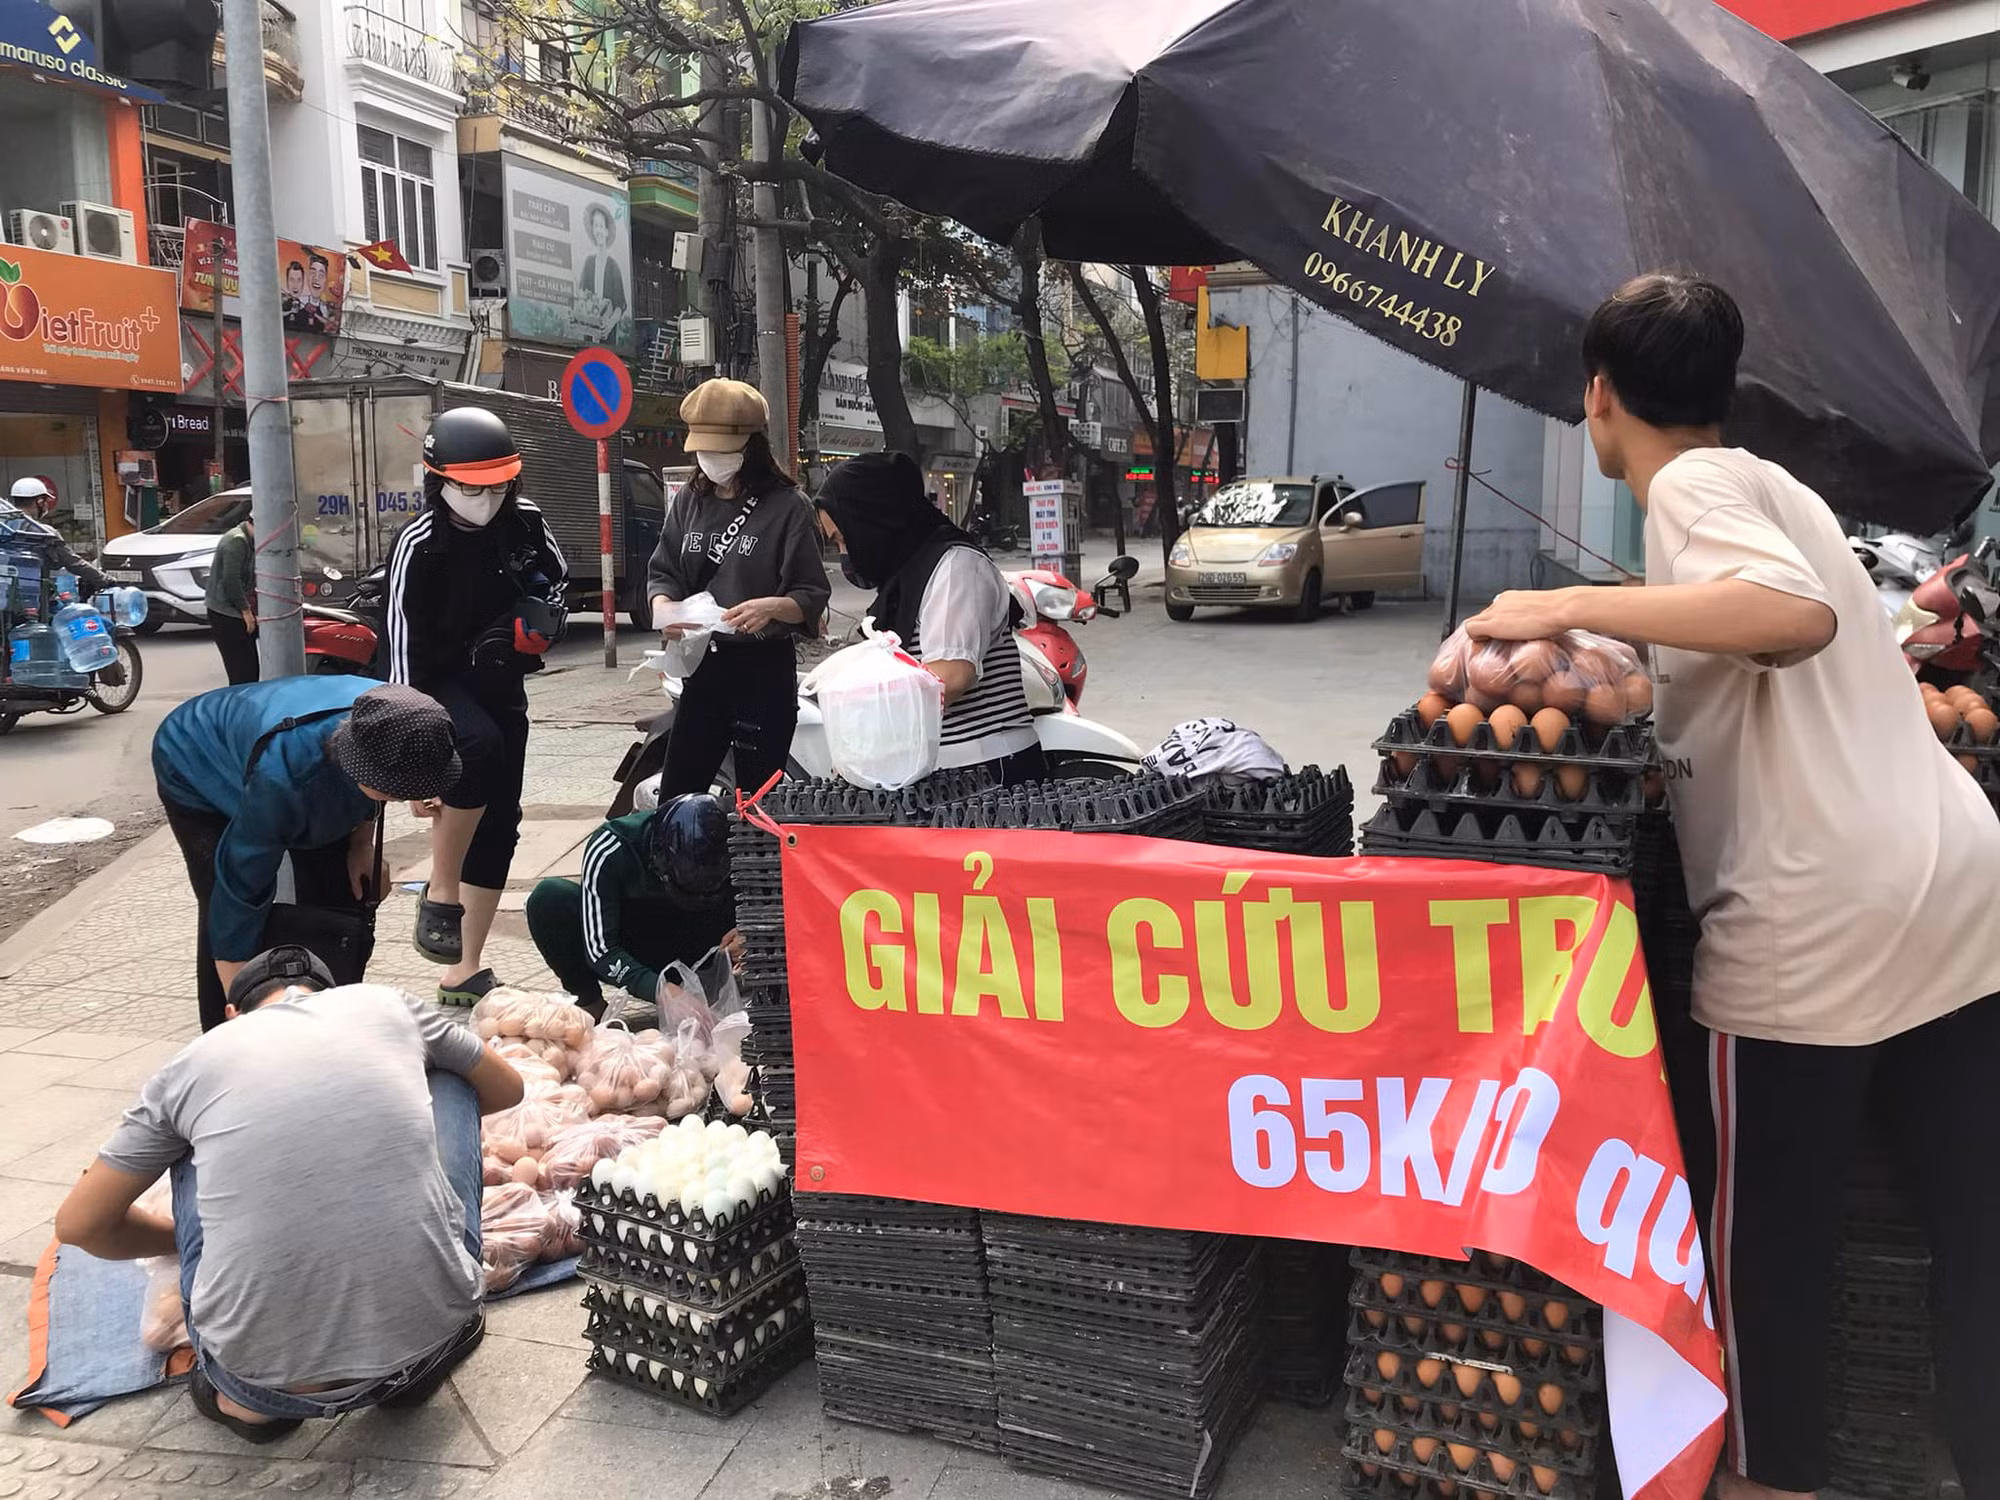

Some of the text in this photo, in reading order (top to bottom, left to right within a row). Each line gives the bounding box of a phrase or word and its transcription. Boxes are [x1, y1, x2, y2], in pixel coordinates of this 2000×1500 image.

[0, 41, 66, 72] maruso
[1321, 197, 1496, 297] KHANH LY
[1304, 251, 1462, 347] 0966744438
[177, 414, 209, 430] Bread
[318, 495, 350, 515] 29H
[376, 491, 424, 513] 045.3
[838, 849, 1065, 1023] GIẢI
[1106, 871, 1381, 1034] CỨU
